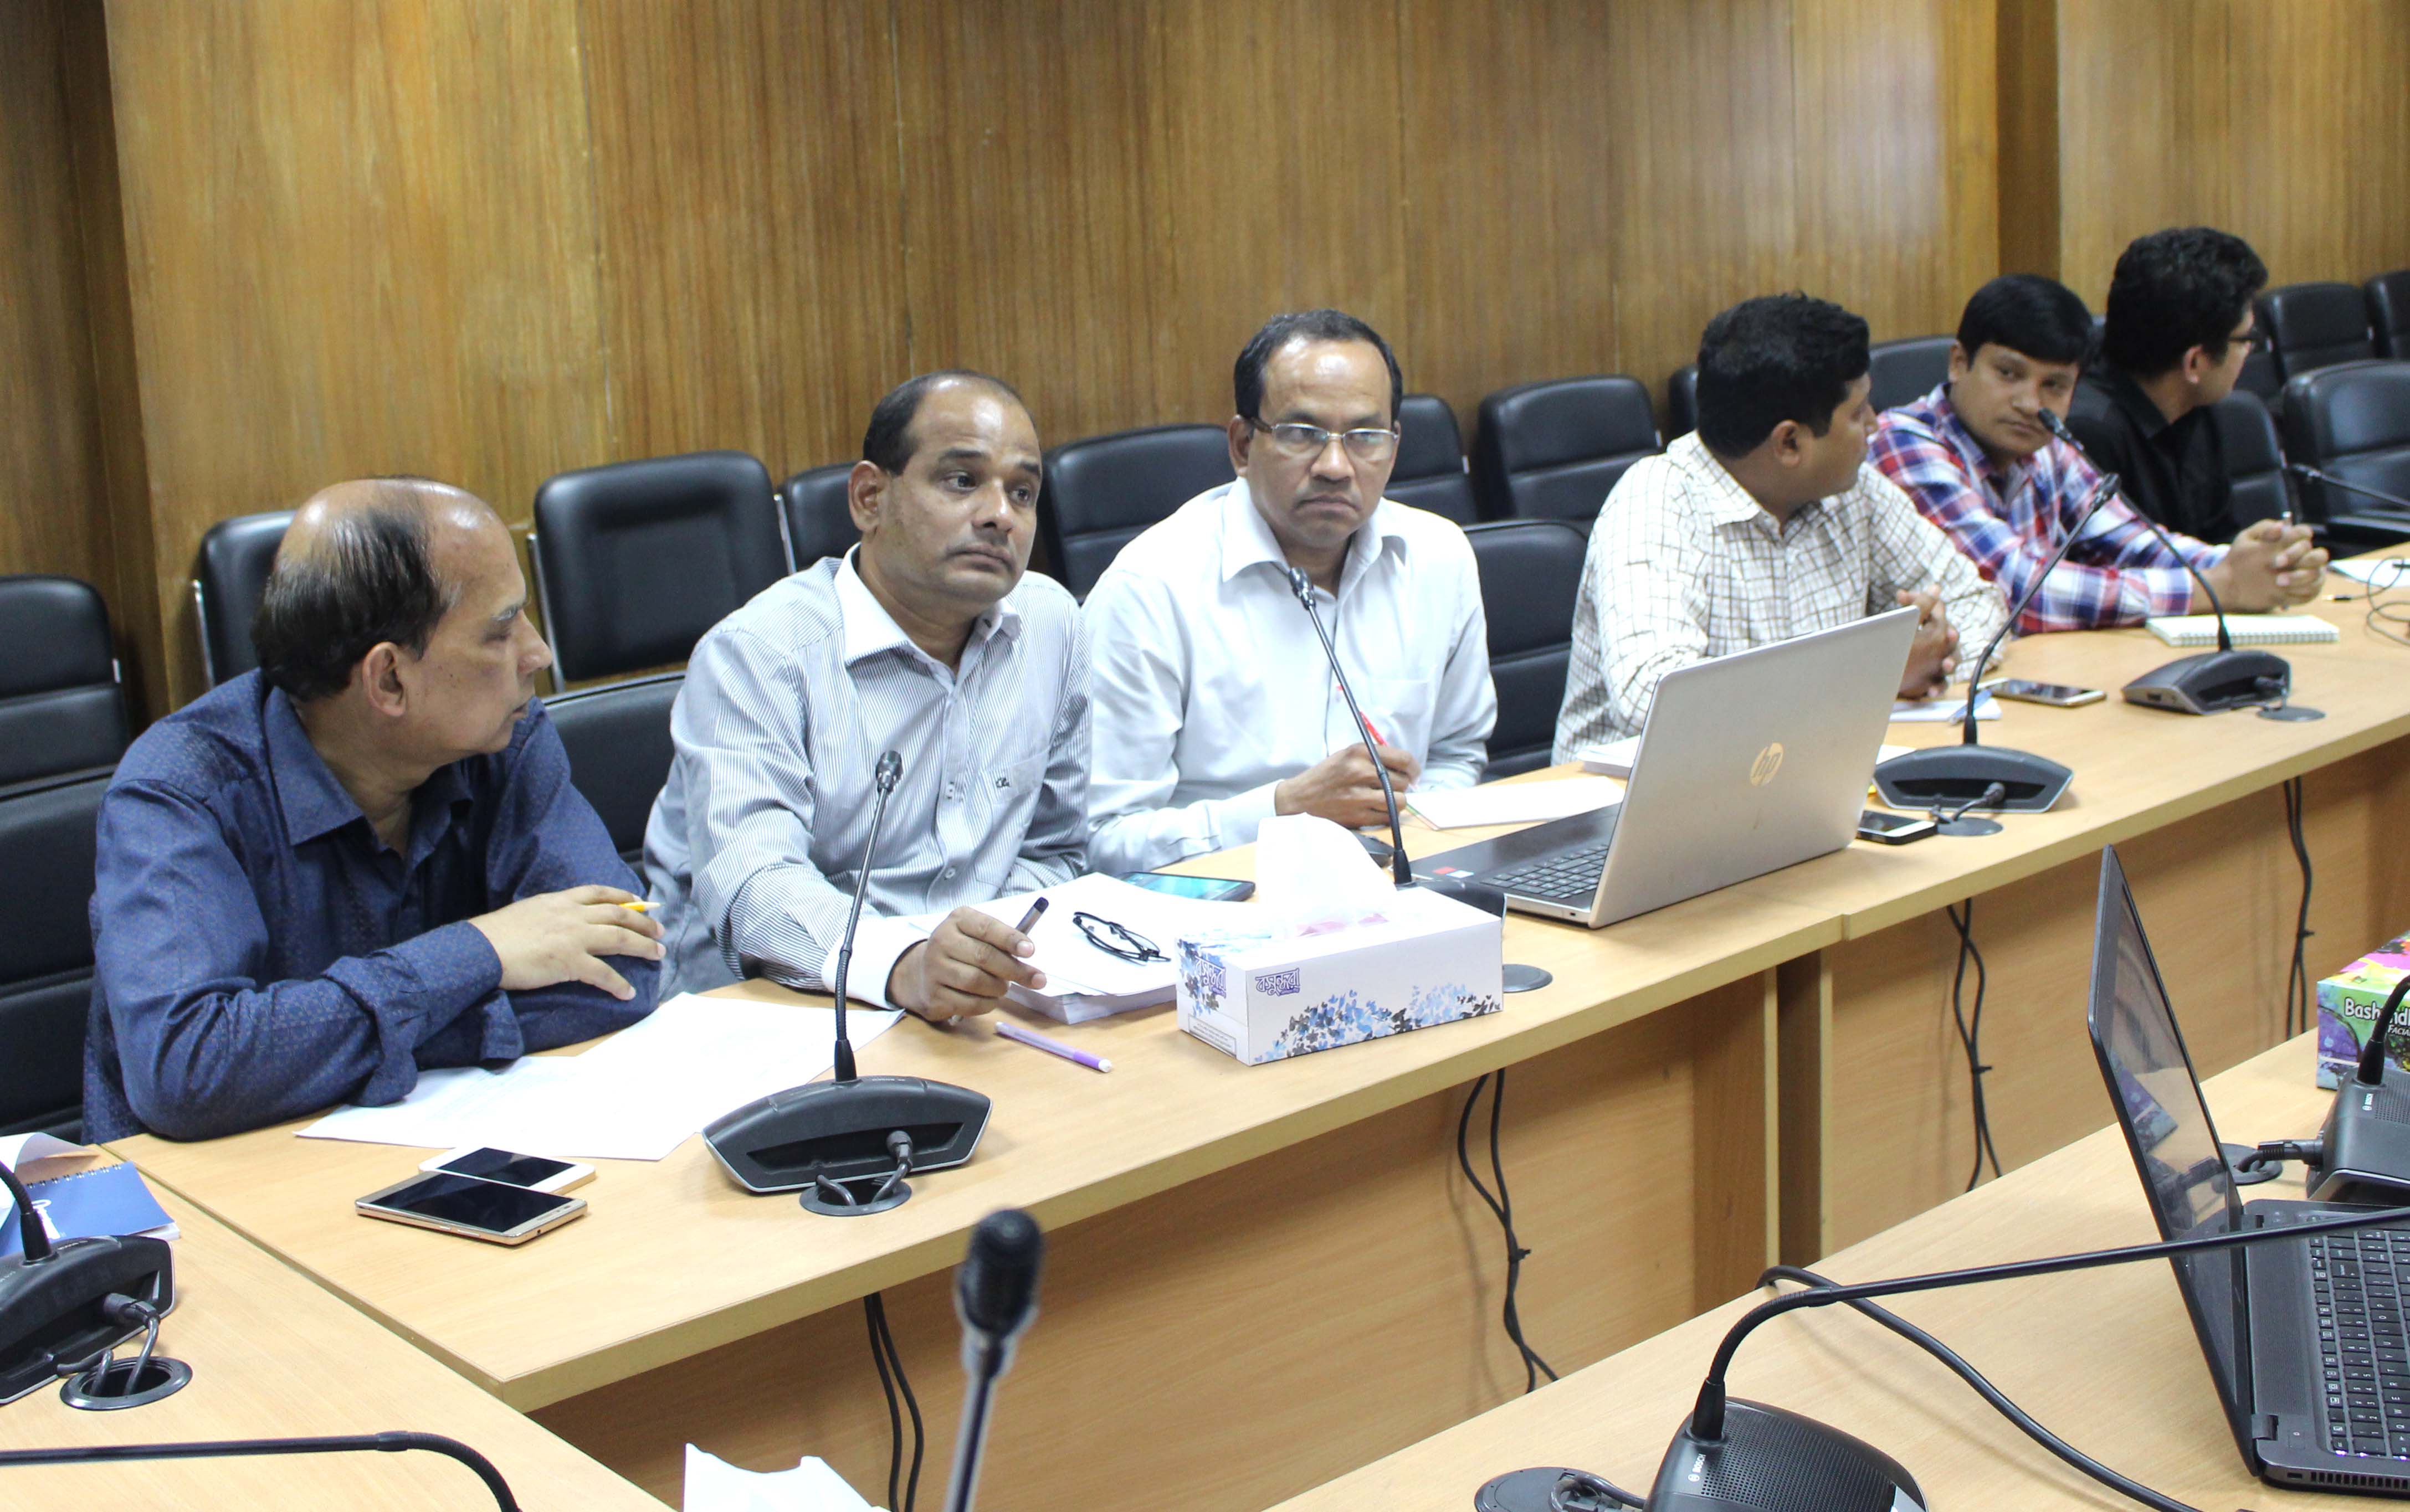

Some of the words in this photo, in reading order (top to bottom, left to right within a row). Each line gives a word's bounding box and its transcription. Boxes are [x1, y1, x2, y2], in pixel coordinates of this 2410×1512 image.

[1752, 746, 1782, 785] hp
[1255, 968, 1300, 996] বসুন্ধরা
[1692, 1453, 1706, 1473] BOSCH
